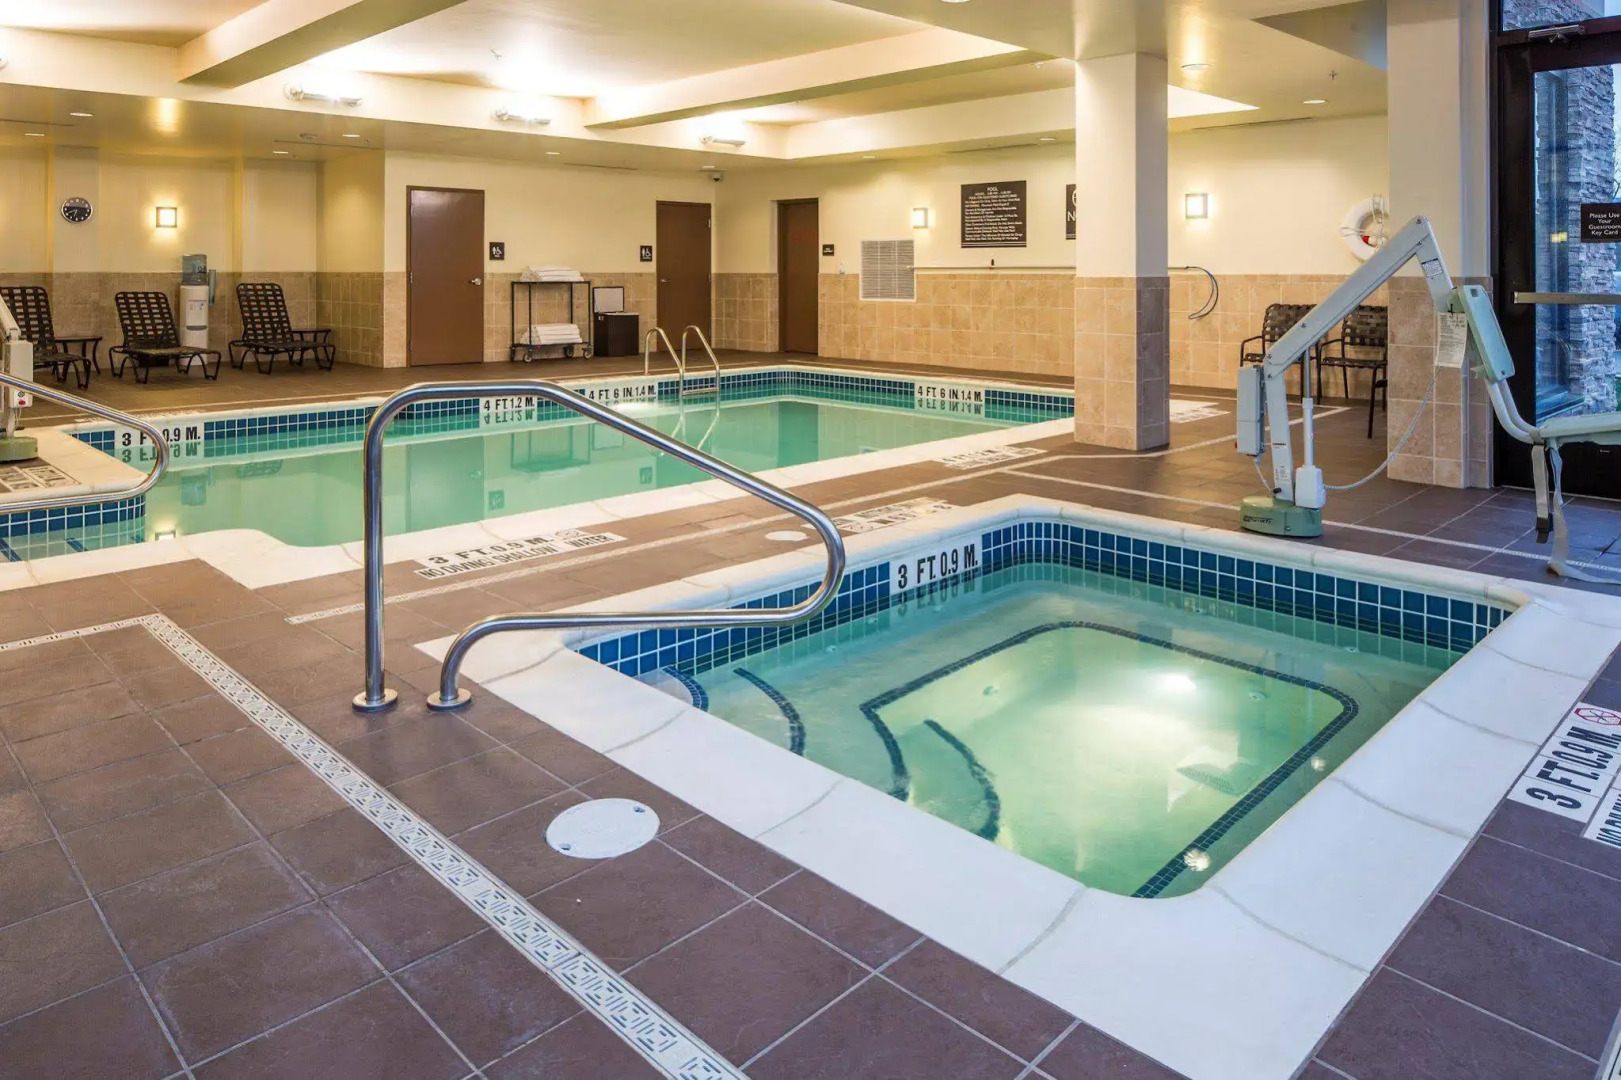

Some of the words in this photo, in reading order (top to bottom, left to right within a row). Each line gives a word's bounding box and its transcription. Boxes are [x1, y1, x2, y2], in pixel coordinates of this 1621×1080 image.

[589, 390, 595, 399] 4
[613, 388, 619, 399] 6
[917, 386, 924, 397] 4
[940, 388, 946, 398] 6
[484, 400, 490, 411] 4
[122, 432, 131, 446] 3
[418, 569, 444, 579] NO
[443, 558, 493, 576] DIVING
[492, 545, 559, 564] SHALLOW
[565, 534, 614, 548] WATER
[428, 556, 449, 564] 3
[898, 564, 907, 589] 3
[940, 549, 958, 577] 0.9
[1526, 787, 1582, 809] 3
